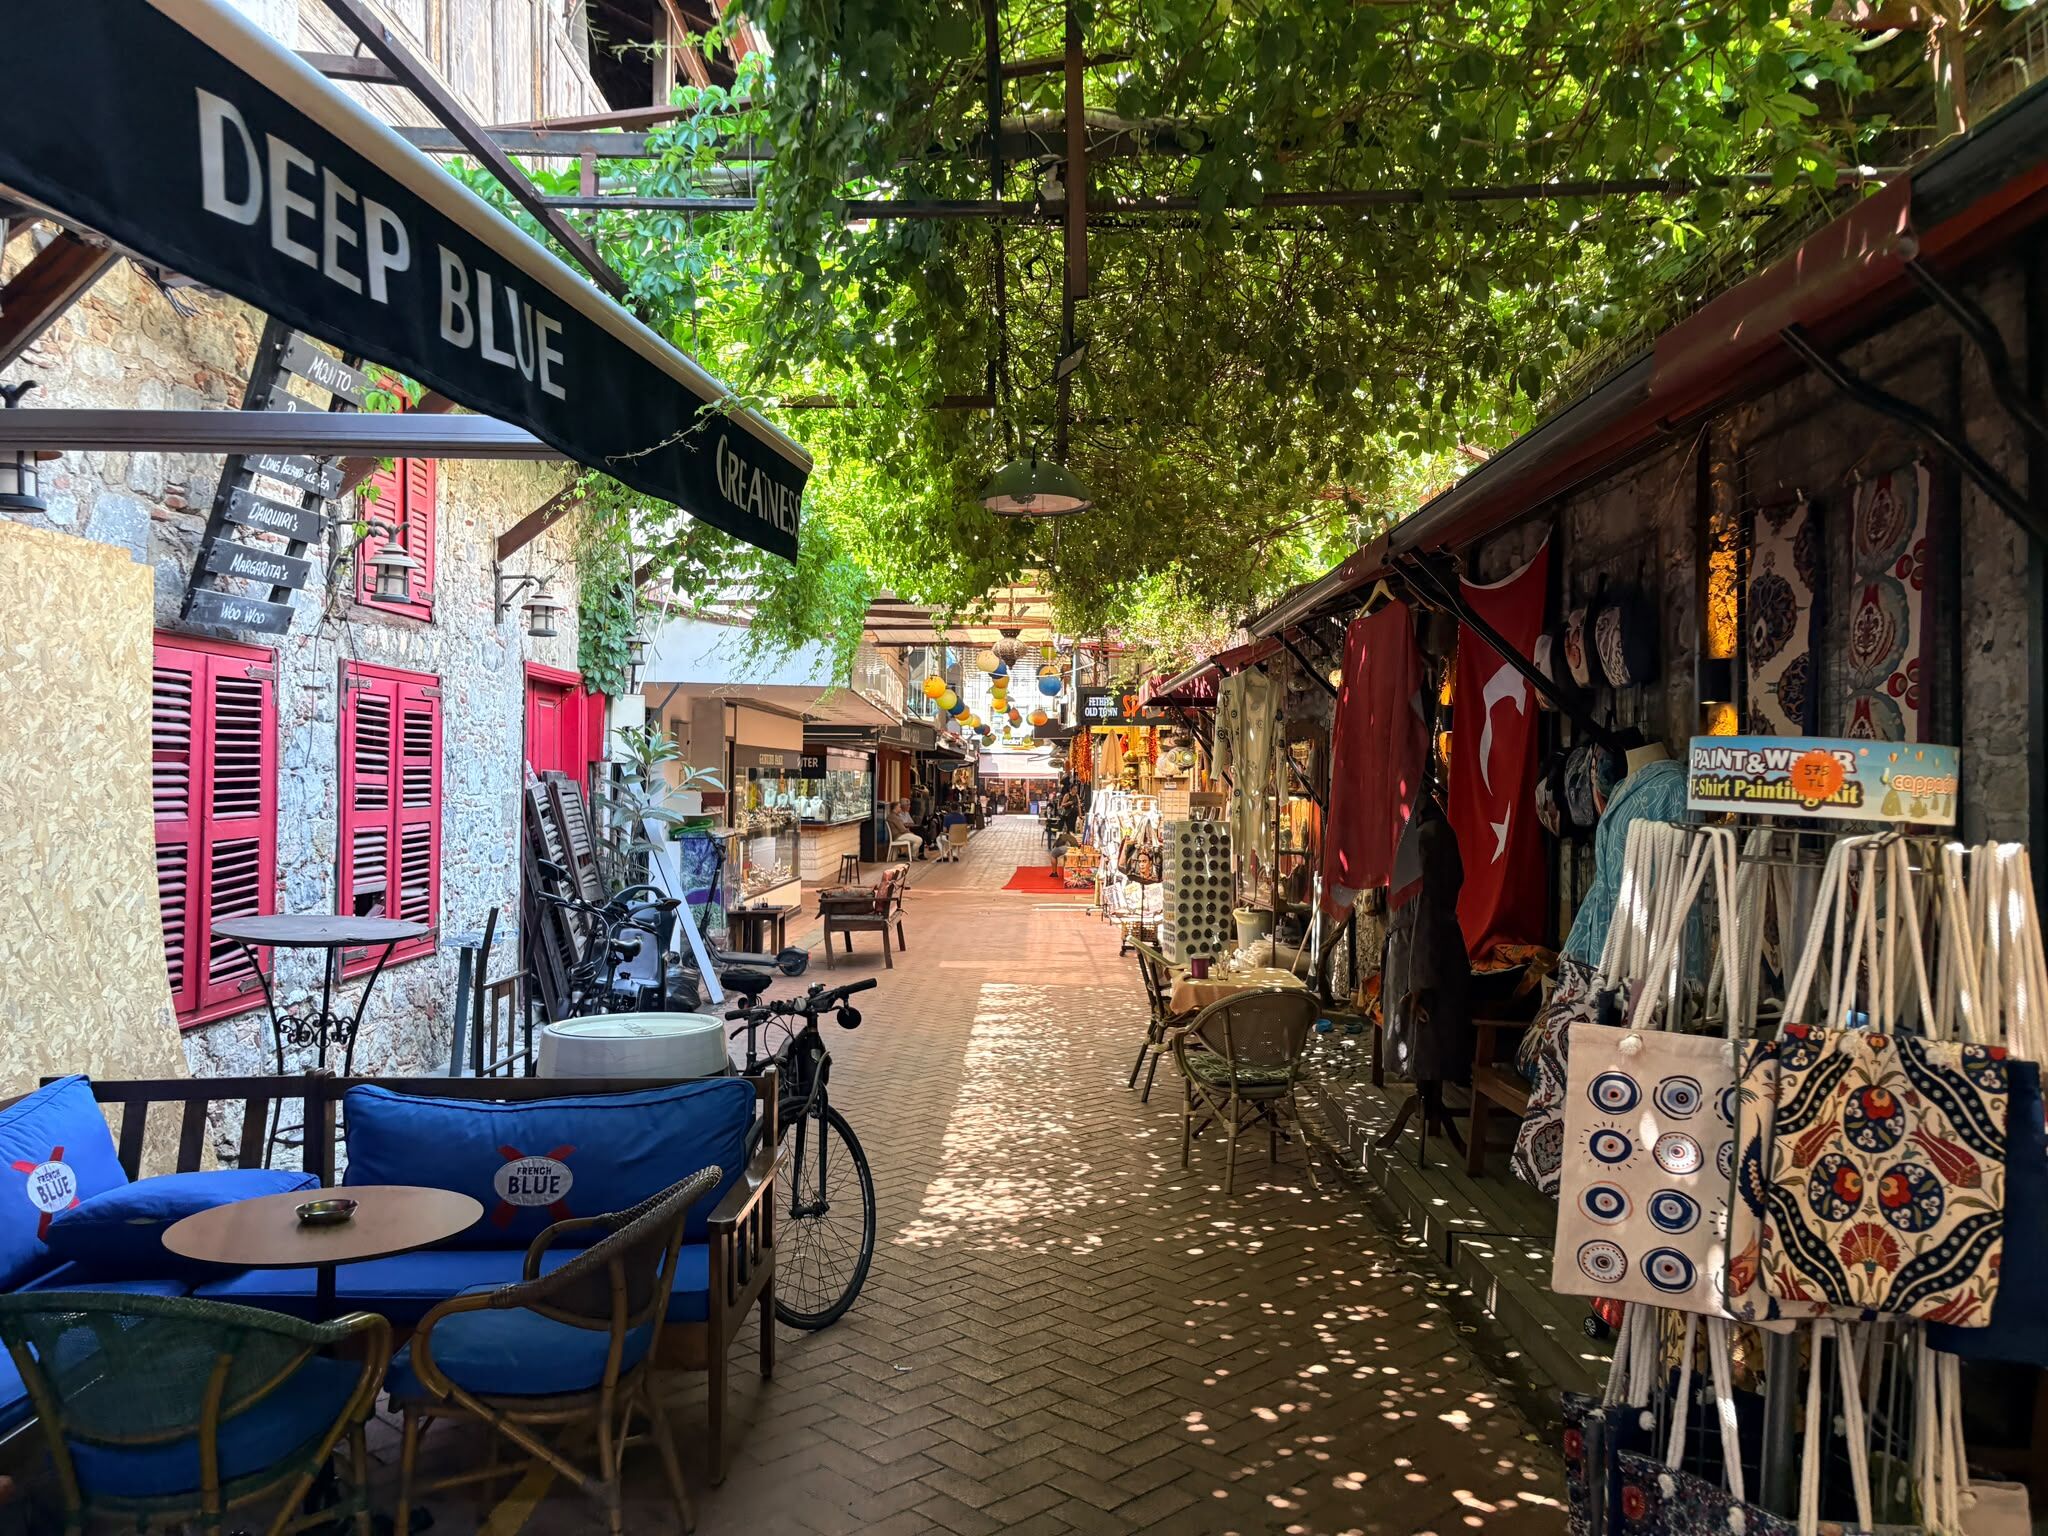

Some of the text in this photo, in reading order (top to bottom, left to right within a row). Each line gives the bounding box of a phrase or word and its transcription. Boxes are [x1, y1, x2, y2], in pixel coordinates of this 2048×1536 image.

[195, 86, 566, 400] DEEP BLUE
[307, 355, 352, 392] MOJITO
[259, 454, 281, 473] LONG
[1084, 707, 1118, 718] OLD TOWN
[1691, 778, 1730, 797] T-Shirt
[516, 1166, 552, 1176] FRENCH
[36, 1175, 72, 1205] BLUE
[508, 1175, 561, 1195] BLUE
